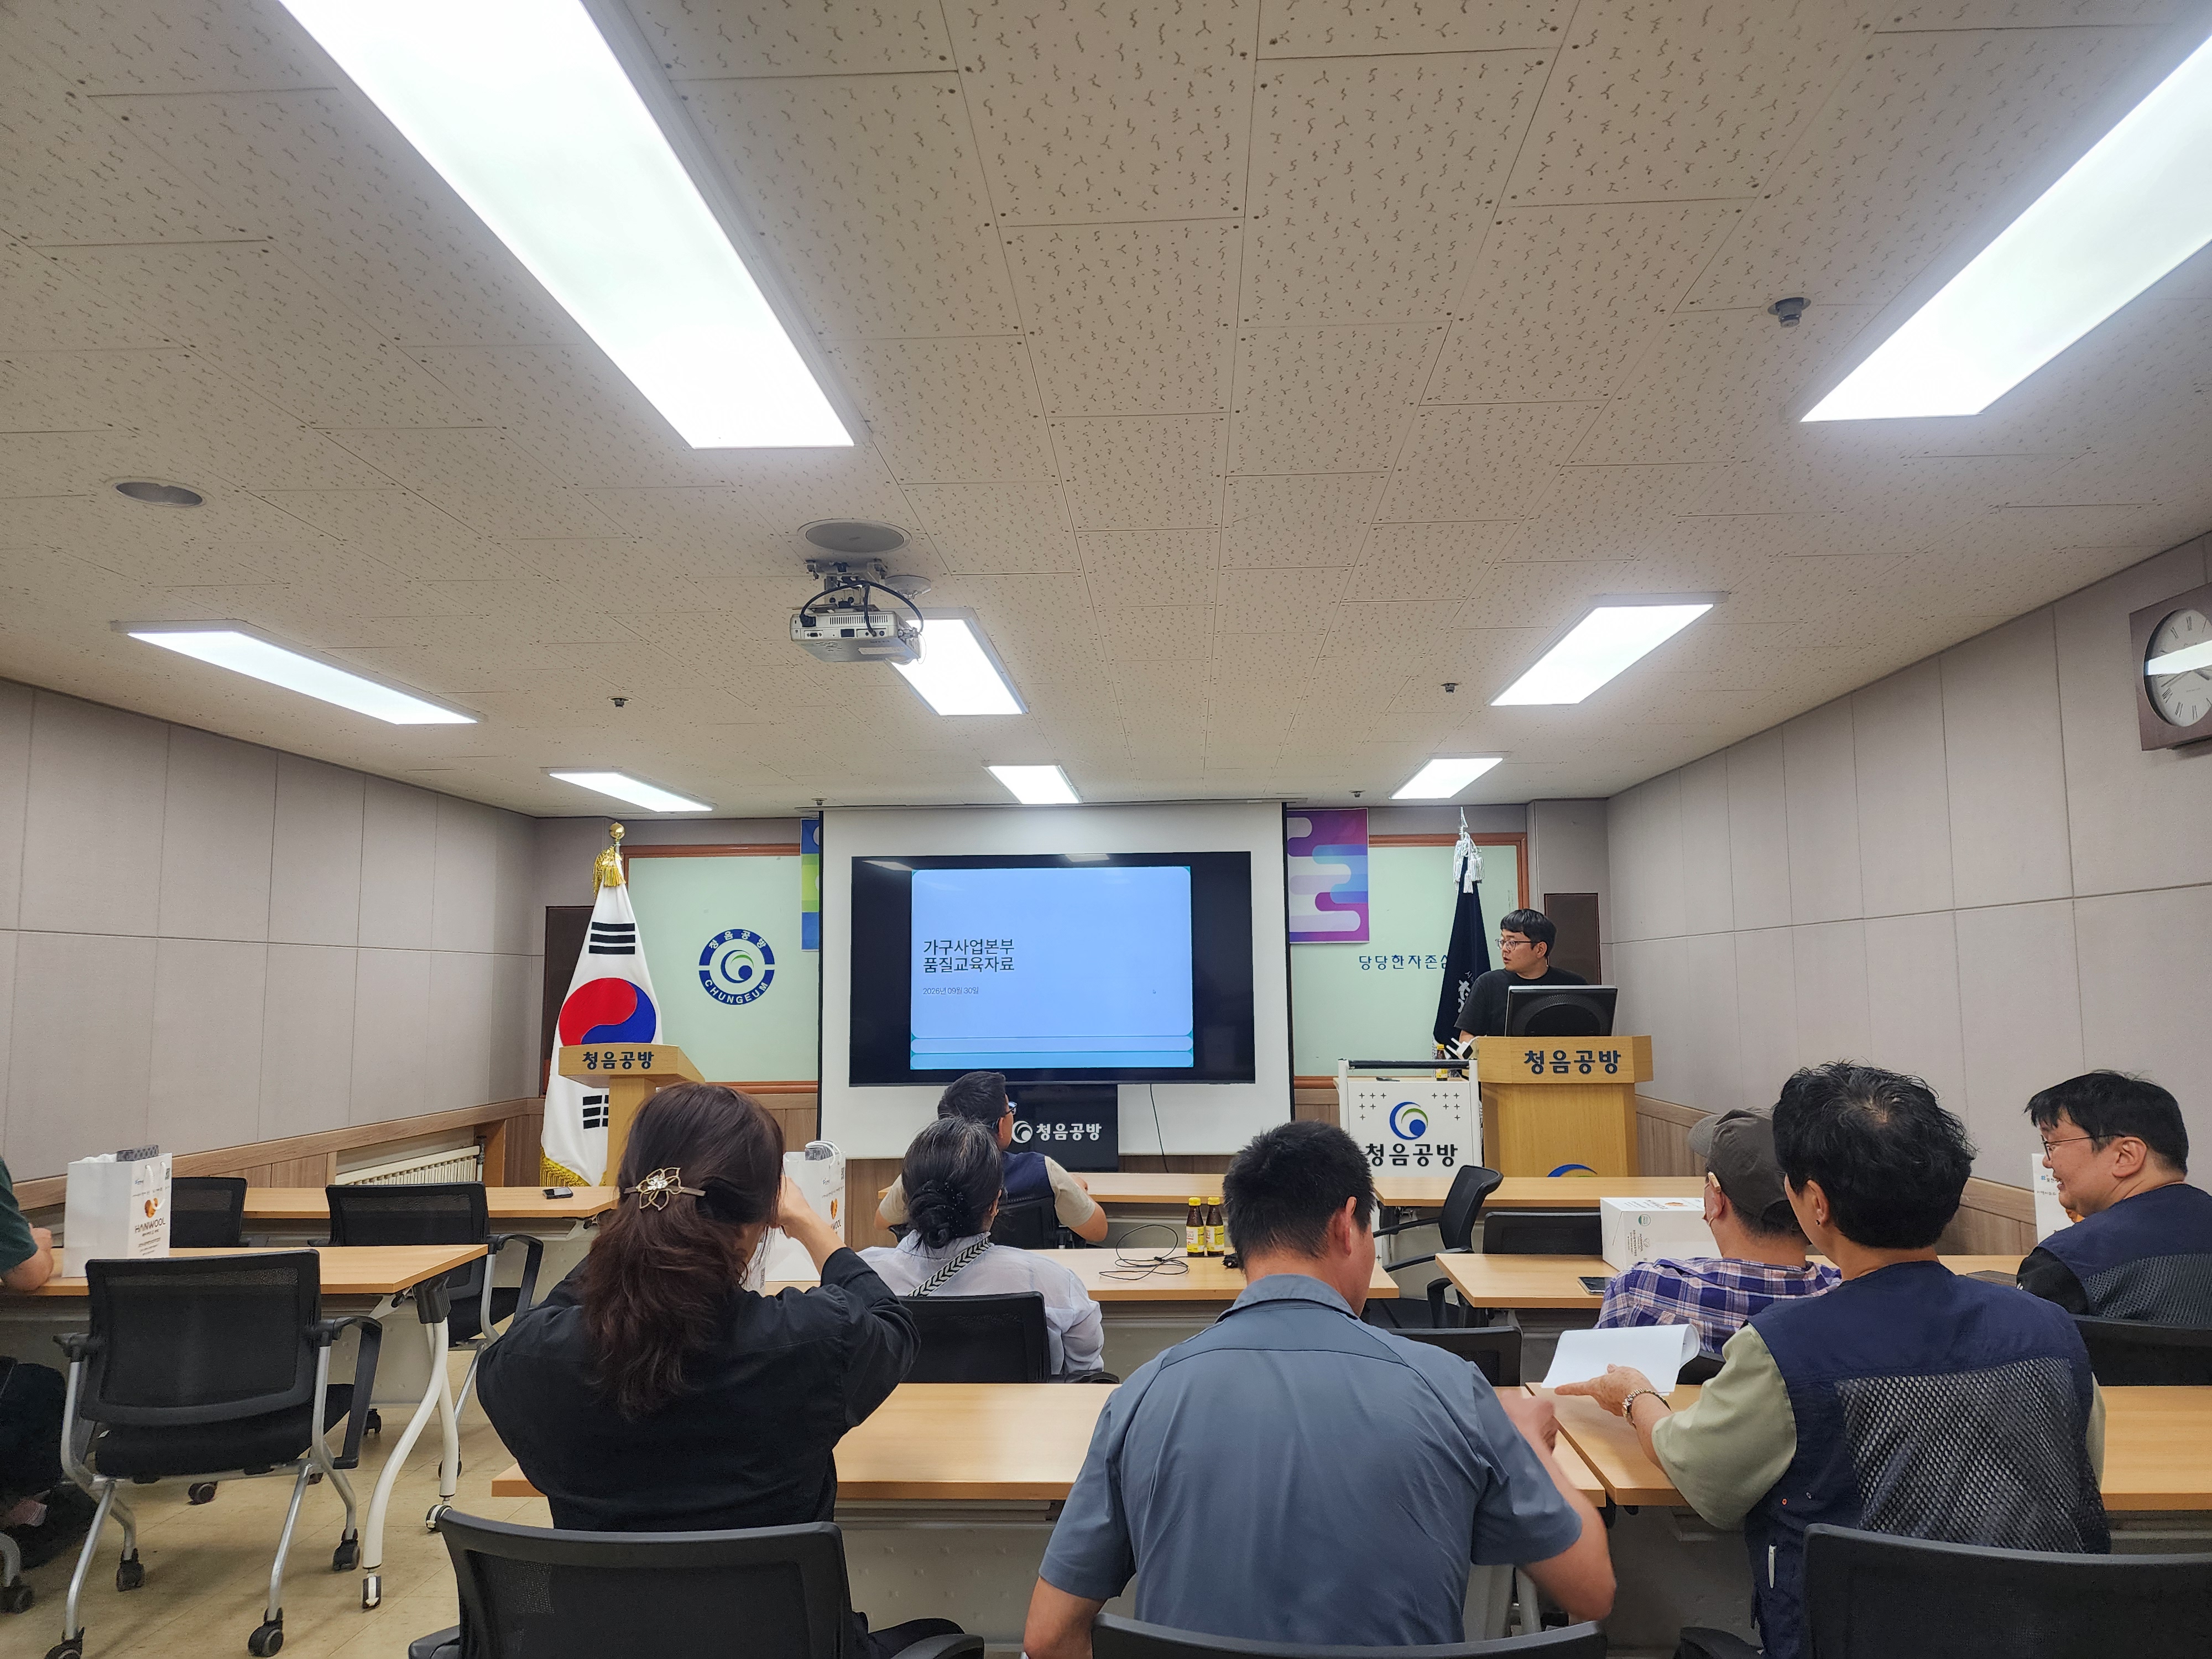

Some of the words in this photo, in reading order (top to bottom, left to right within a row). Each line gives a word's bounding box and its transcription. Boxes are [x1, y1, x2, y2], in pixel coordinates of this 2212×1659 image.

[708, 931, 766, 948] 청음공방
[923, 938, 1015, 955] 가구사업본부
[923, 956, 1015, 973] 품질교육자료
[705, 979, 768, 1004] CHUNGEUM
[922, 987, 946, 995] 2026년
[947, 987, 962, 995] 09월
[963, 986, 979, 995] 30일
[582, 1051, 655, 1070] 청음공방
[1524, 1050, 1621, 1074] 청음공방
[1036, 1123, 1102, 1141] 청음공방
[1365, 1142, 1458, 1167] 청음공방
[134, 1217, 166, 1234] HANWOOL
